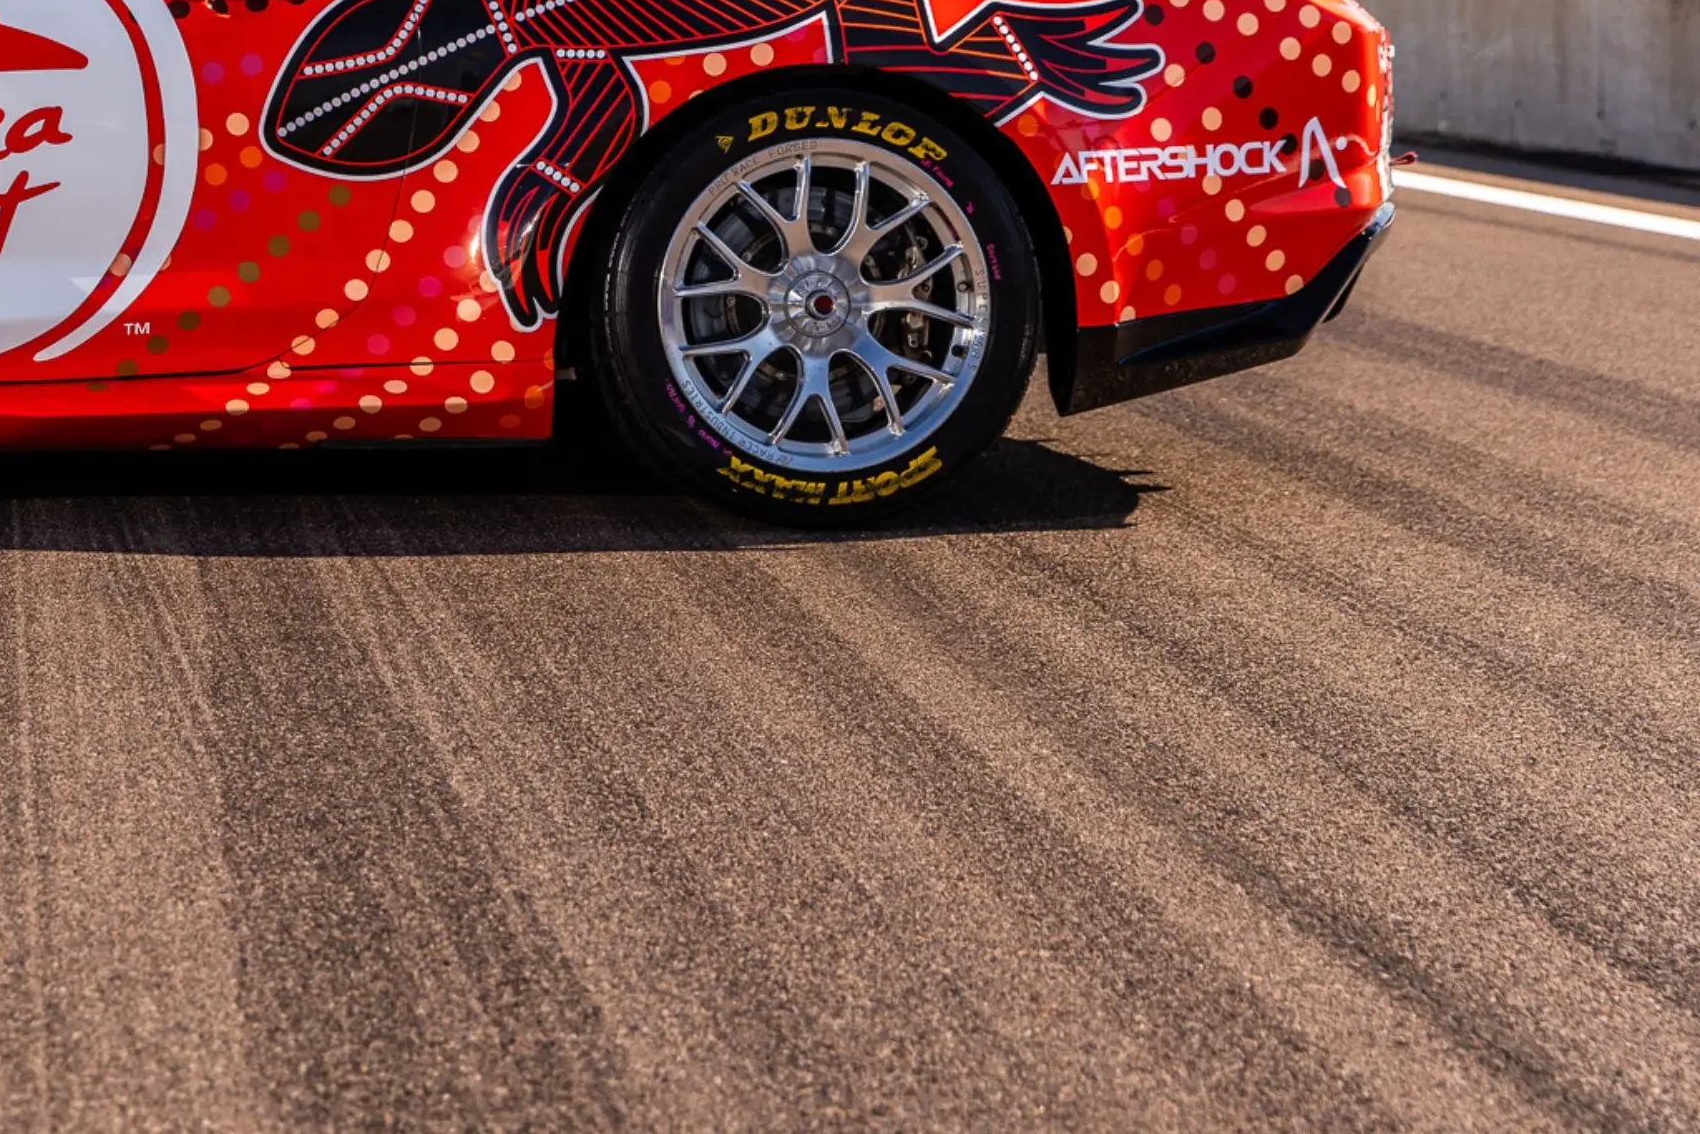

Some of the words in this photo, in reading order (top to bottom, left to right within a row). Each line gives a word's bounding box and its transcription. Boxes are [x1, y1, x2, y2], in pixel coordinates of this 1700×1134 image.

[747, 106, 948, 163] DUNLOP
[1050, 139, 1287, 185] AFTERSHOCK
[124, 322, 151, 336] TM
[716, 454, 826, 506] MAXX
[827, 445, 943, 506] SPORT
